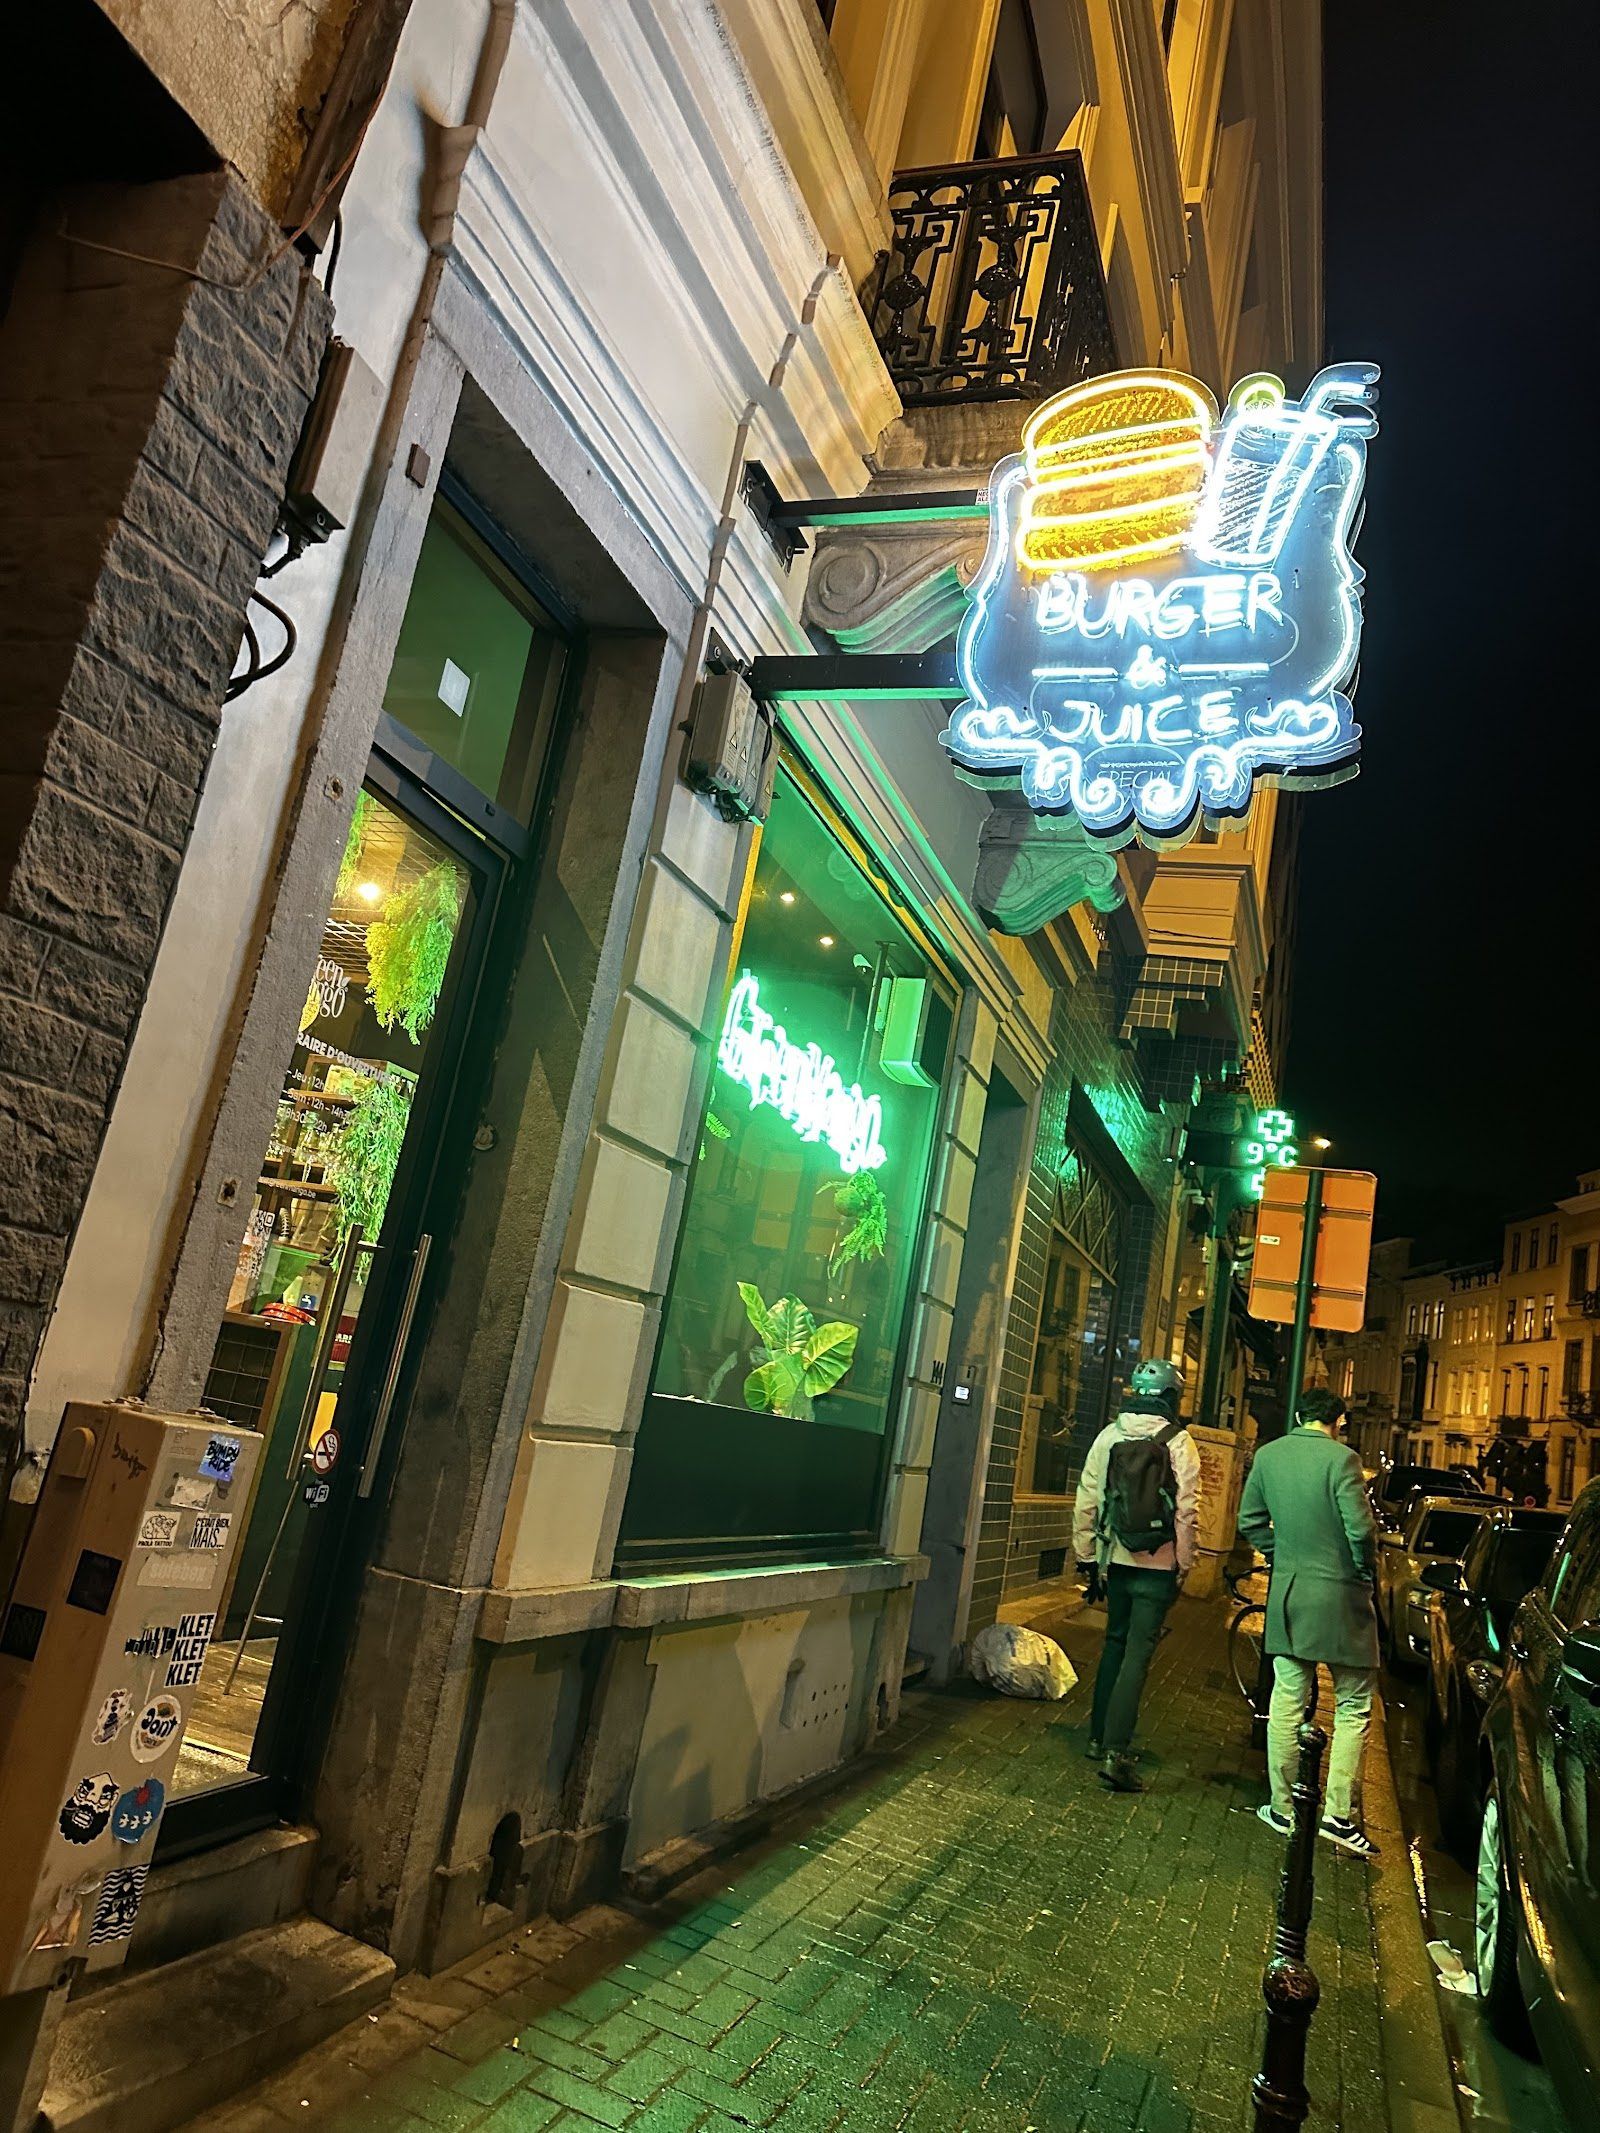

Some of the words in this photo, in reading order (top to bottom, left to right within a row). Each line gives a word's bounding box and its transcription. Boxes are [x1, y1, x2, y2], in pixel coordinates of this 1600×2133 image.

[1036, 571, 1284, 639] BURGER
[1126, 644, 1167, 690] &
[1049, 690, 1239, 746] JUICE
[1247, 1141, 1298, 1167] 9°C
[178, 1615, 214, 1638] KLET
[171, 1638, 208, 1662] KLET
[165, 1662, 202, 1686] KLET
